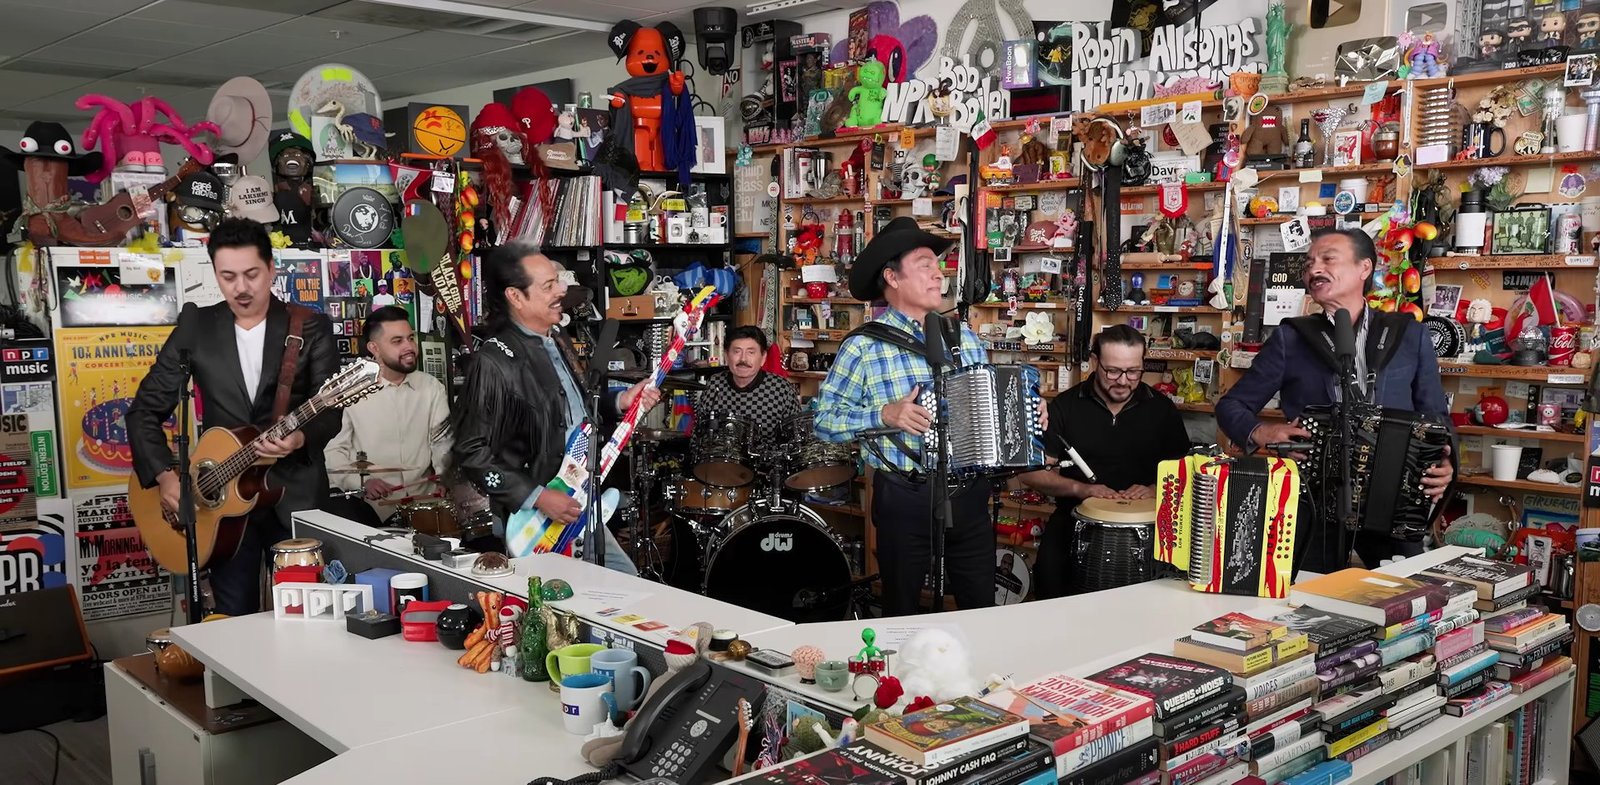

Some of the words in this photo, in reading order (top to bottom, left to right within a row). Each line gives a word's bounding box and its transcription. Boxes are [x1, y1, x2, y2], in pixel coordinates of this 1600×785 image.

[1072, 21, 1135, 71] Robin
[1149, 17, 1254, 74] Allsongs
[938, 54, 980, 95] Bob
[1004, 45, 1013, 84] HwaBoon
[723, 71, 739, 84] NO
[1072, 66, 1150, 113] Hilton
[522, 117, 532, 128] P
[749, 126, 771, 145] KISS
[191, 181, 212, 191] café
[735, 180, 763, 195] Glass
[736, 208, 753, 223] Etu
[296, 278, 306, 291] ON
[307, 278, 321, 290] THE
[1271, 272, 1288, 283] GOD
[299, 289, 319, 302] ROAD
[440, 287, 458, 315] MAGIC
[449, 286, 463, 313] GIRL
[1077, 283, 1087, 322] Rodgers
[120, 331, 149, 342] MUSIC
[993, 340, 1023, 352] RUBIO
[5, 349, 47, 361] npr
[95, 343, 162, 360] ANNIVERSA
[6, 361, 49, 376] music
[85, 361, 125, 370] CONCERT
[0, 414, 28, 433] SIC
[37, 436, 47, 464] INTERN
[40, 463, 51, 492] EDITION
[78, 516, 106, 525] AUSTIN
[95, 535, 134, 557] MORNING
[760, 535, 794, 555] dw
[774, 533, 794, 541] drums
[0, 551, 41, 594] PR
[81, 563, 102, 577] yo
[106, 558, 121, 572] la
[82, 590, 120, 603] DOORS
[123, 586, 150, 598] OPEN
[151, 584, 163, 592] at
[164, 583, 170, 591] 7
[280, 589, 362, 618] npr
[1019, 684, 1078, 708] WOMEN
[1037, 677, 1092, 698] MUSIC
[1163, 688, 1196, 712] QUEENS
[1195, 686, 1202, 696] of
[1201, 676, 1225, 695] NOISE
[1254, 678, 1278, 699] VOICES
[1070, 702, 1114, 718] HOW
[1090, 729, 1126, 764] PRINCE
[1178, 736, 1200, 753] HARD
[1199, 726, 1222, 744] STUFF
[847, 745, 929, 776] JOHNNY
[1273, 741, 1312, 765] McCARTNEY
[926, 766, 959, 785] JOHNNY
[959, 757, 981, 775] CASH
[981, 751, 998, 766] FAQ
